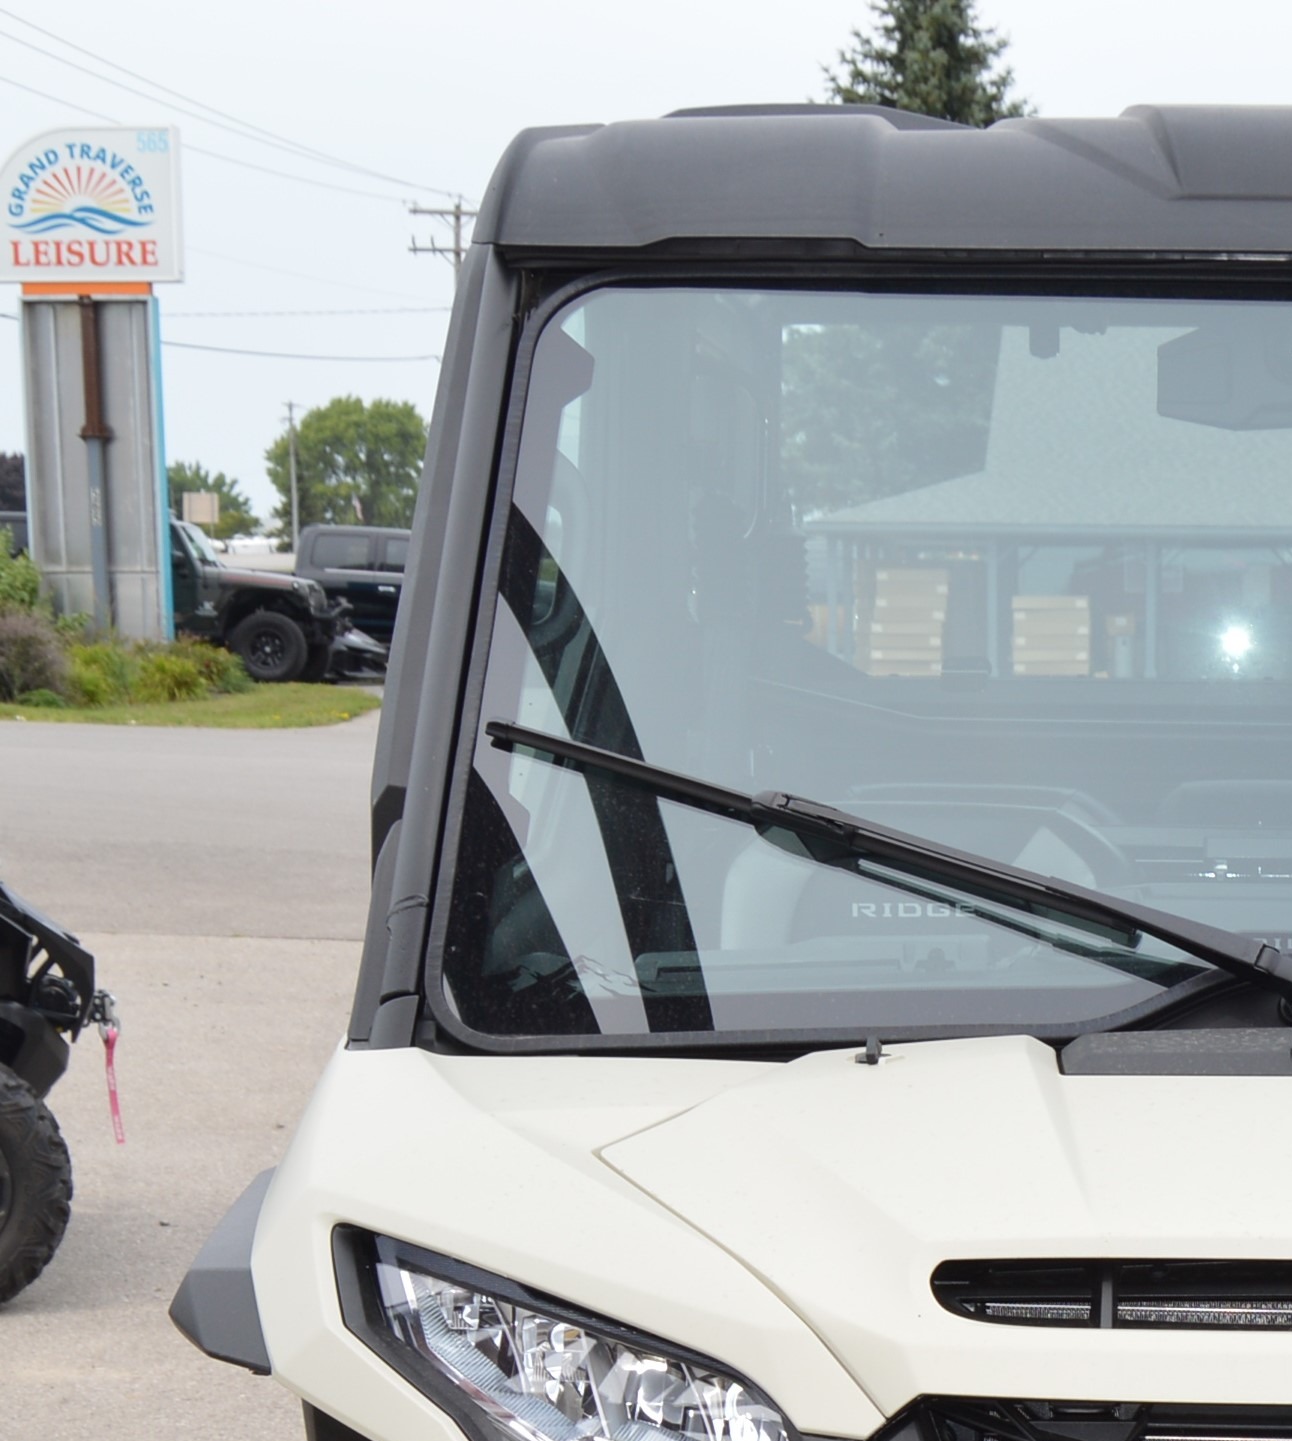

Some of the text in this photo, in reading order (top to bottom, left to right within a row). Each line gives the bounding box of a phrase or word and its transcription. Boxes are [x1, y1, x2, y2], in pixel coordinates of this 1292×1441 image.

[8, 142, 153, 217] GRAND TRAVERSE
[10, 239, 158, 267] LEISURE
